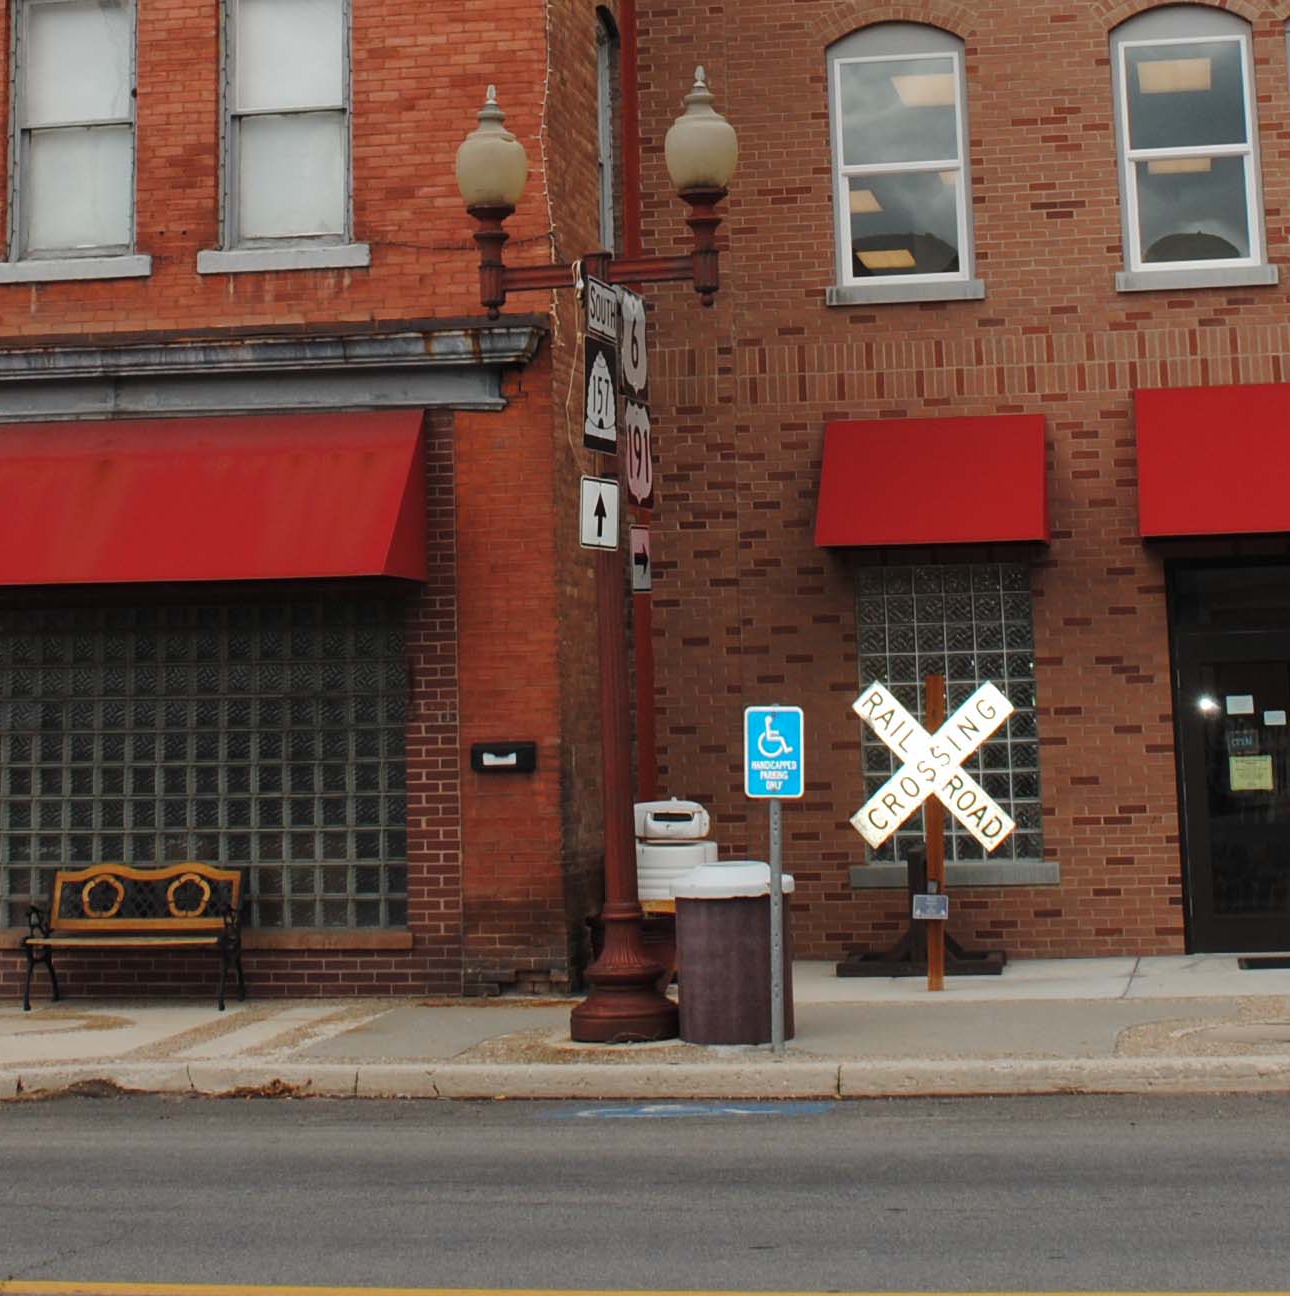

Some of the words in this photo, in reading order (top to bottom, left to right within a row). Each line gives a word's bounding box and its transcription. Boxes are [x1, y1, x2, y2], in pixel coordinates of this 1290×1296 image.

[590, 286, 616, 329] SOUTH
[631, 317, 639, 369] 6
[593, 375, 610, 416] 157
[628, 424, 649, 483] 191
[751, 760, 797, 770] HANDICAPPED
[760, 771, 789, 780] PARKING
[766, 780, 783, 791] ONLY
[862, 691, 915, 752] RAIL
[945, 775, 1002, 840] ROAD
[868, 699, 996, 830] CROSSING
